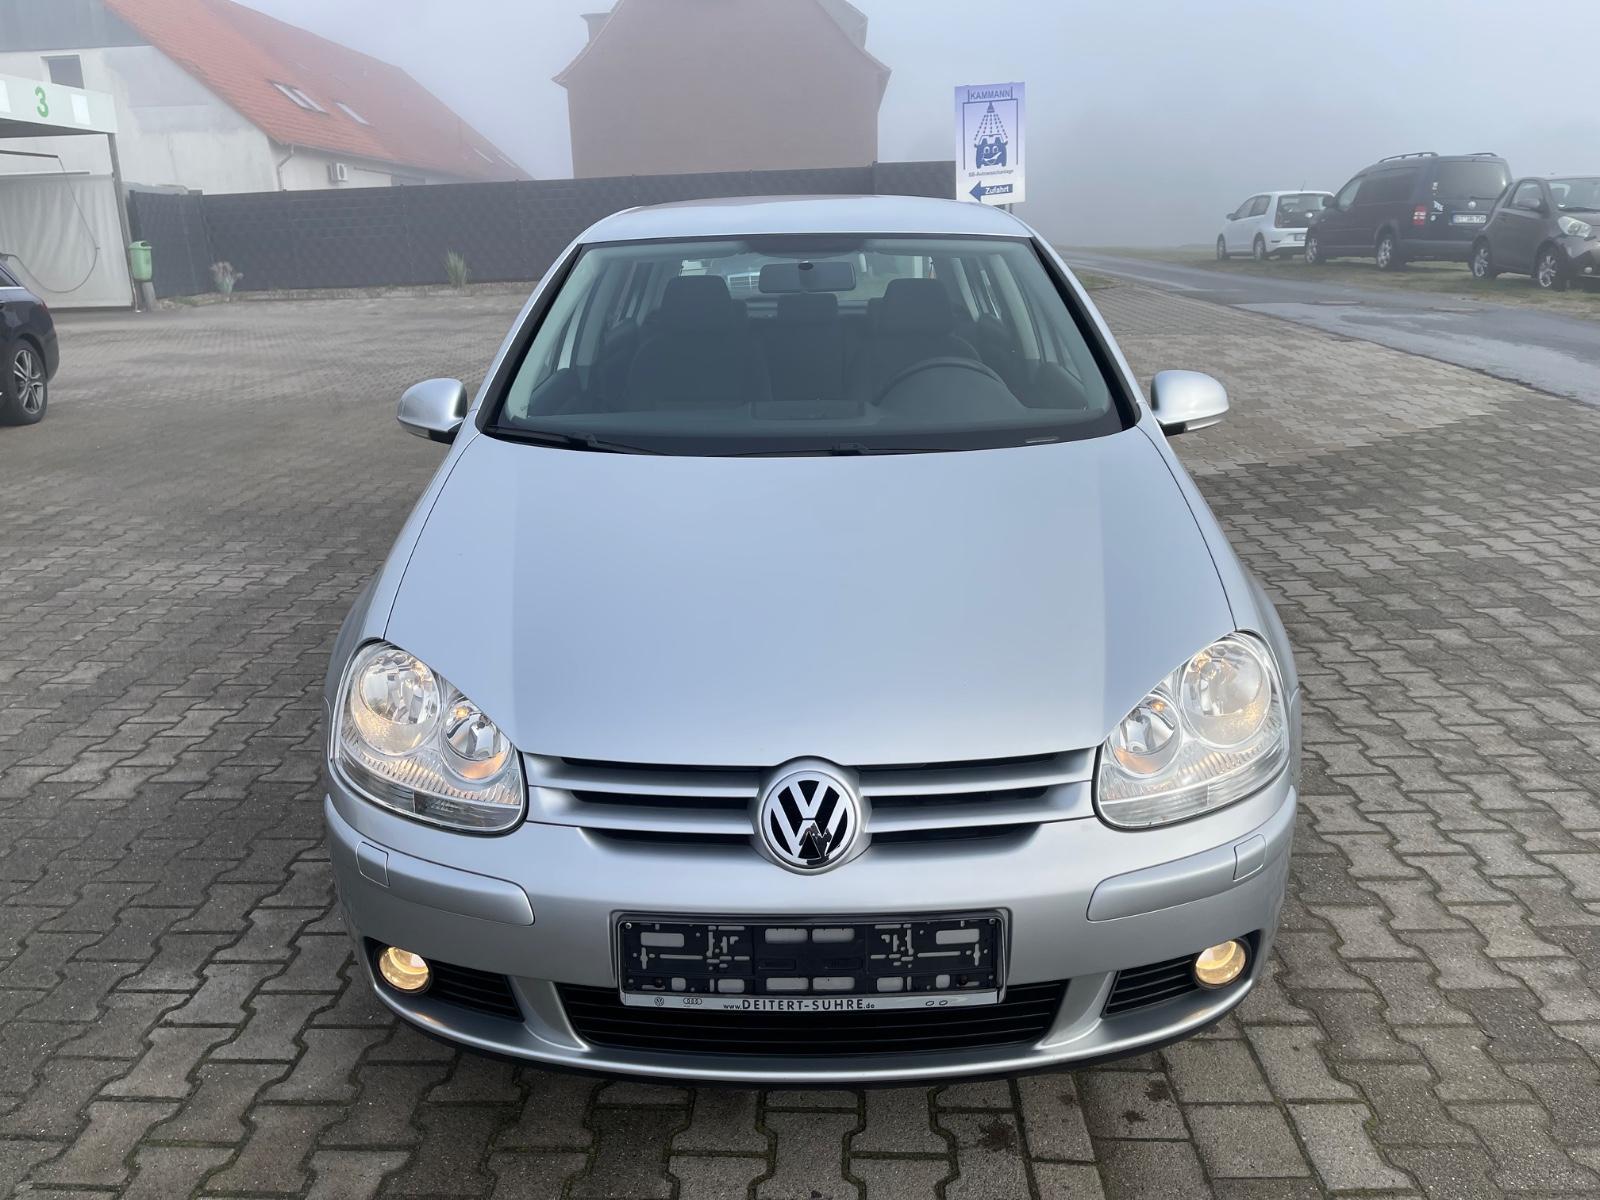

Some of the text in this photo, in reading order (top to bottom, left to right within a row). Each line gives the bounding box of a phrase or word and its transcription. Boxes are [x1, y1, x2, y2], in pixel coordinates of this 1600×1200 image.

[970, 89, 1010, 100] KAMMANN
[34, 86, 49, 118] 3
[985, 185, 1009, 195] Zufahrt
[723, 998, 875, 1010] www.DEITERT-SUHRE.de
